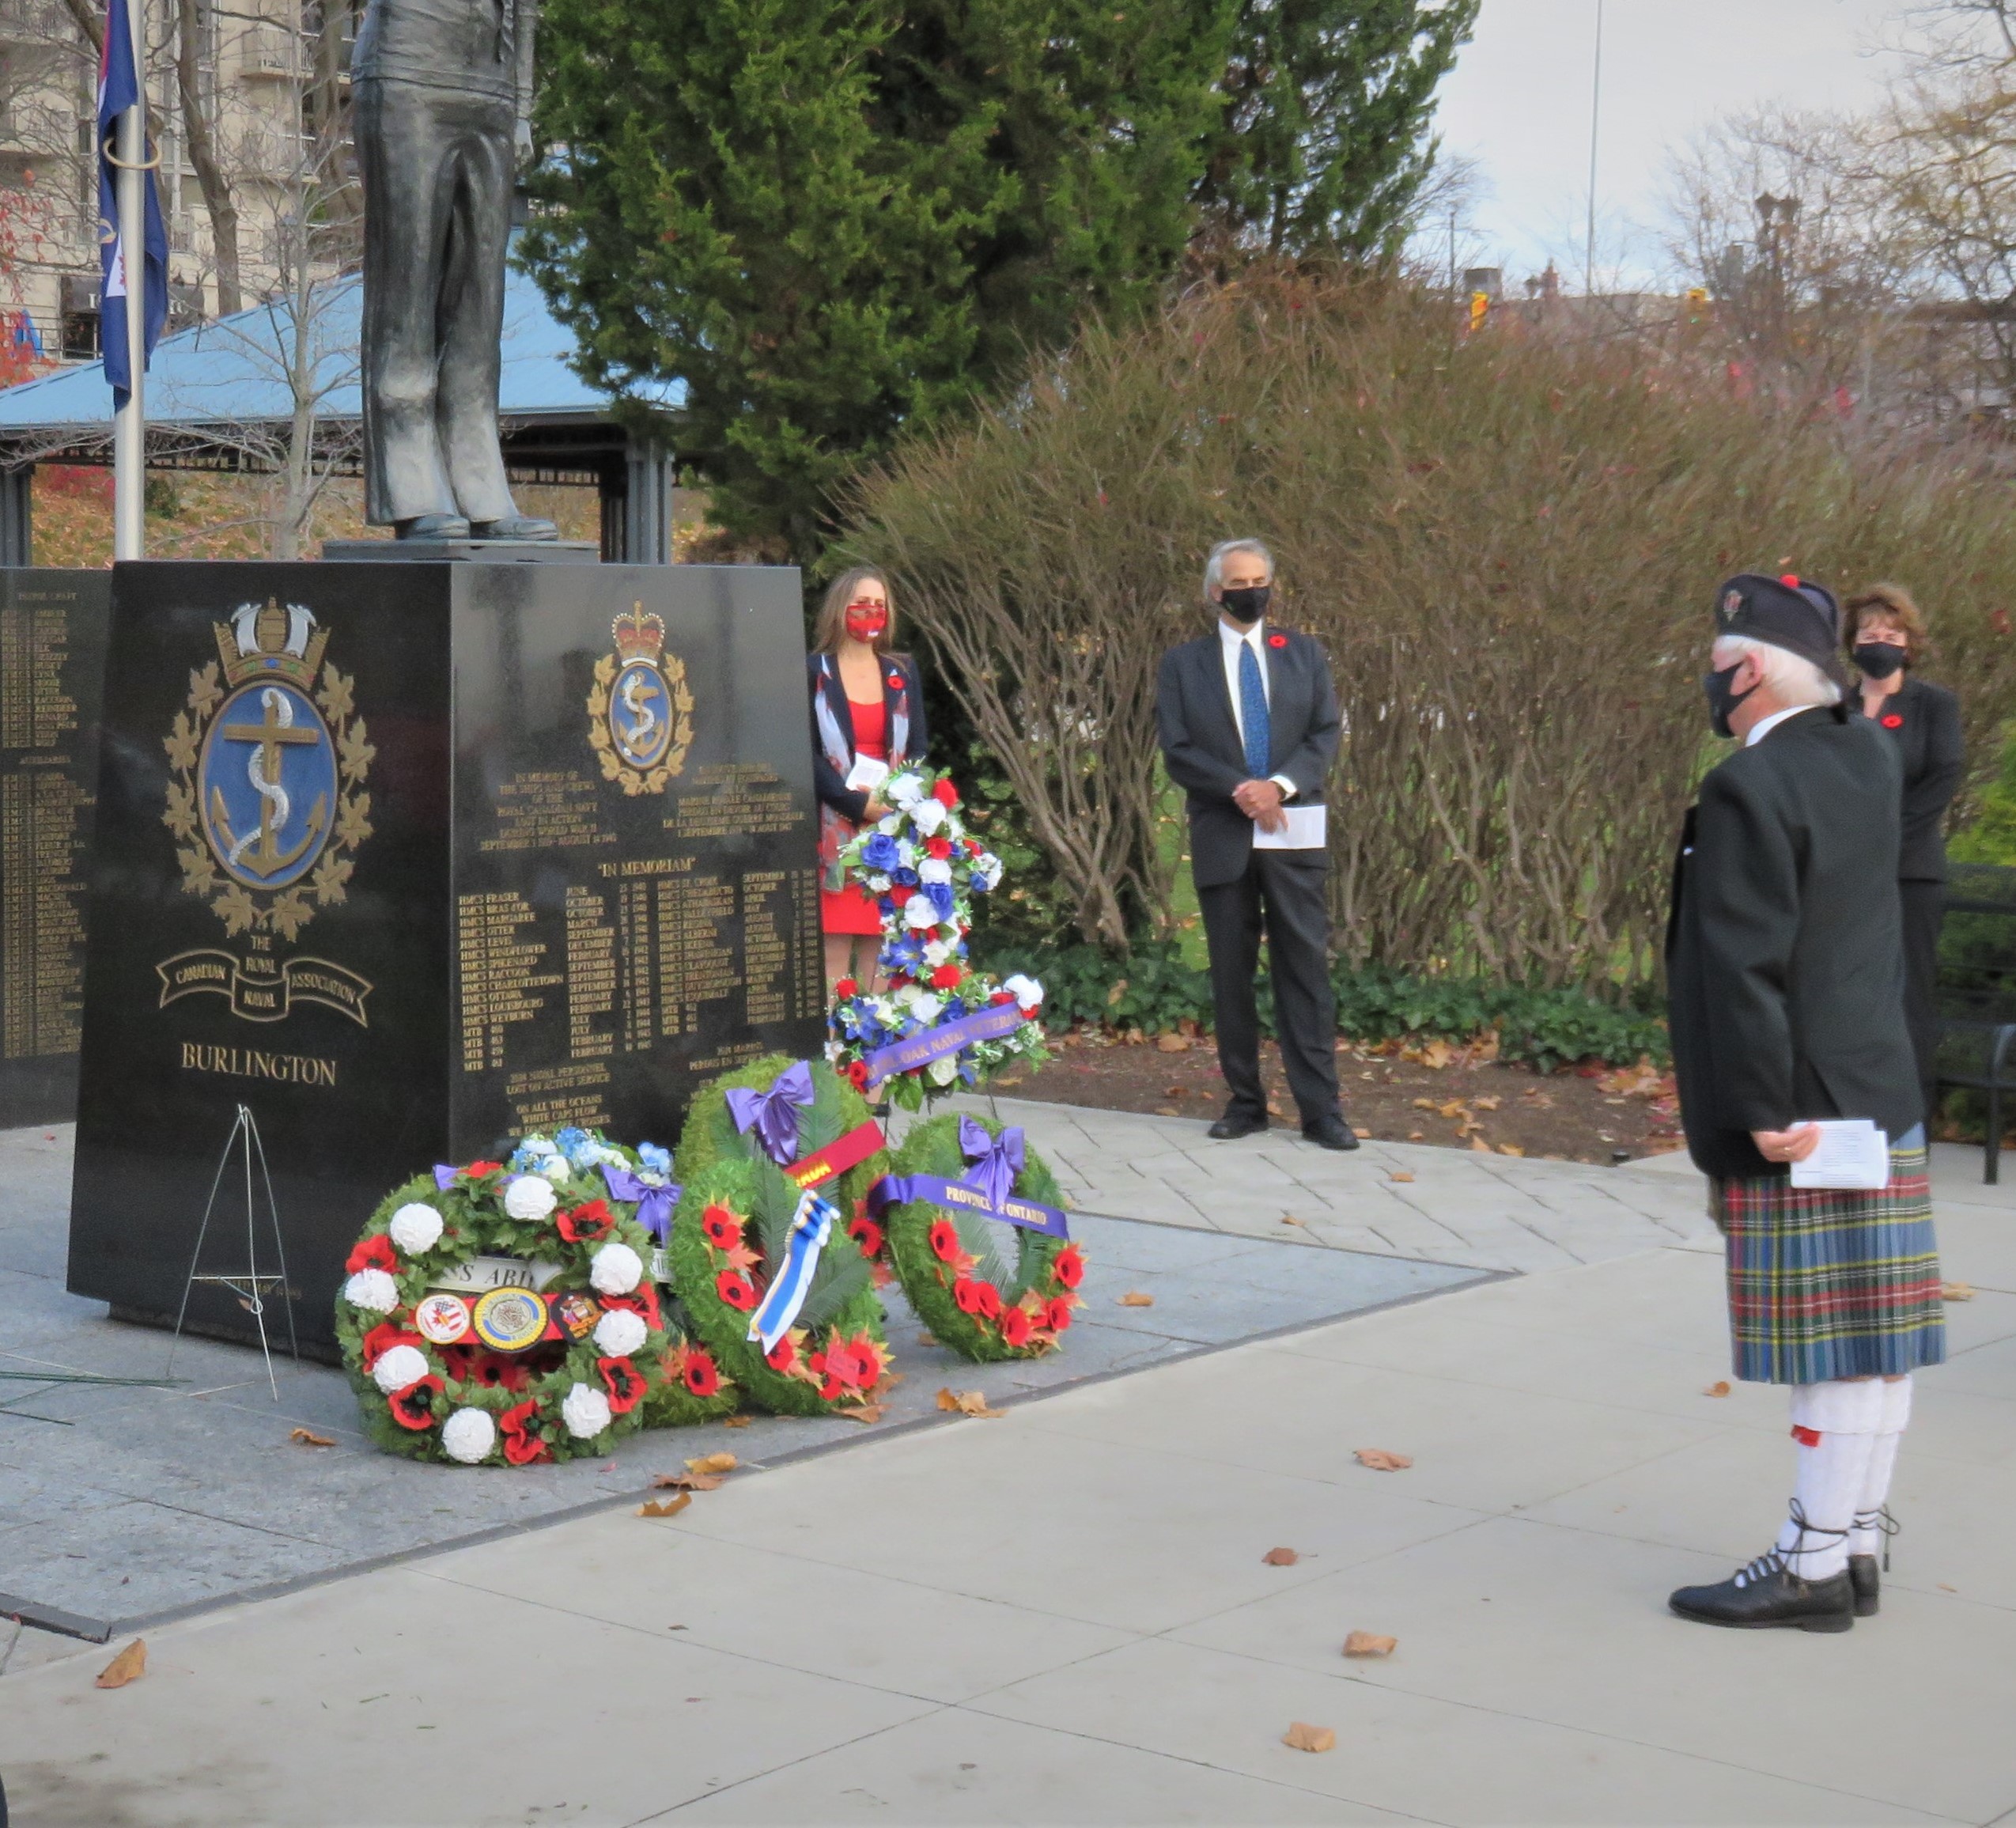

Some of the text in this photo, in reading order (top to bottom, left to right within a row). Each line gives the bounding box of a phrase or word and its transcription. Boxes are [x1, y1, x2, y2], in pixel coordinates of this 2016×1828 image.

[621, 857, 696, 876] MEMORIAM"
[251, 935, 271, 951] THE
[246, 956, 276, 974] ROYAL
[176, 963, 357, 1007] CANADIAN NAVAL ASSOCIATION
[490, 975, 564, 991] CHARLOTTETOWN
[929, 1031, 966, 1054] NAVAL
[181, 1042, 337, 1087] BURLINGTON
[1006, 1203, 1047, 1226] ONTARIO
